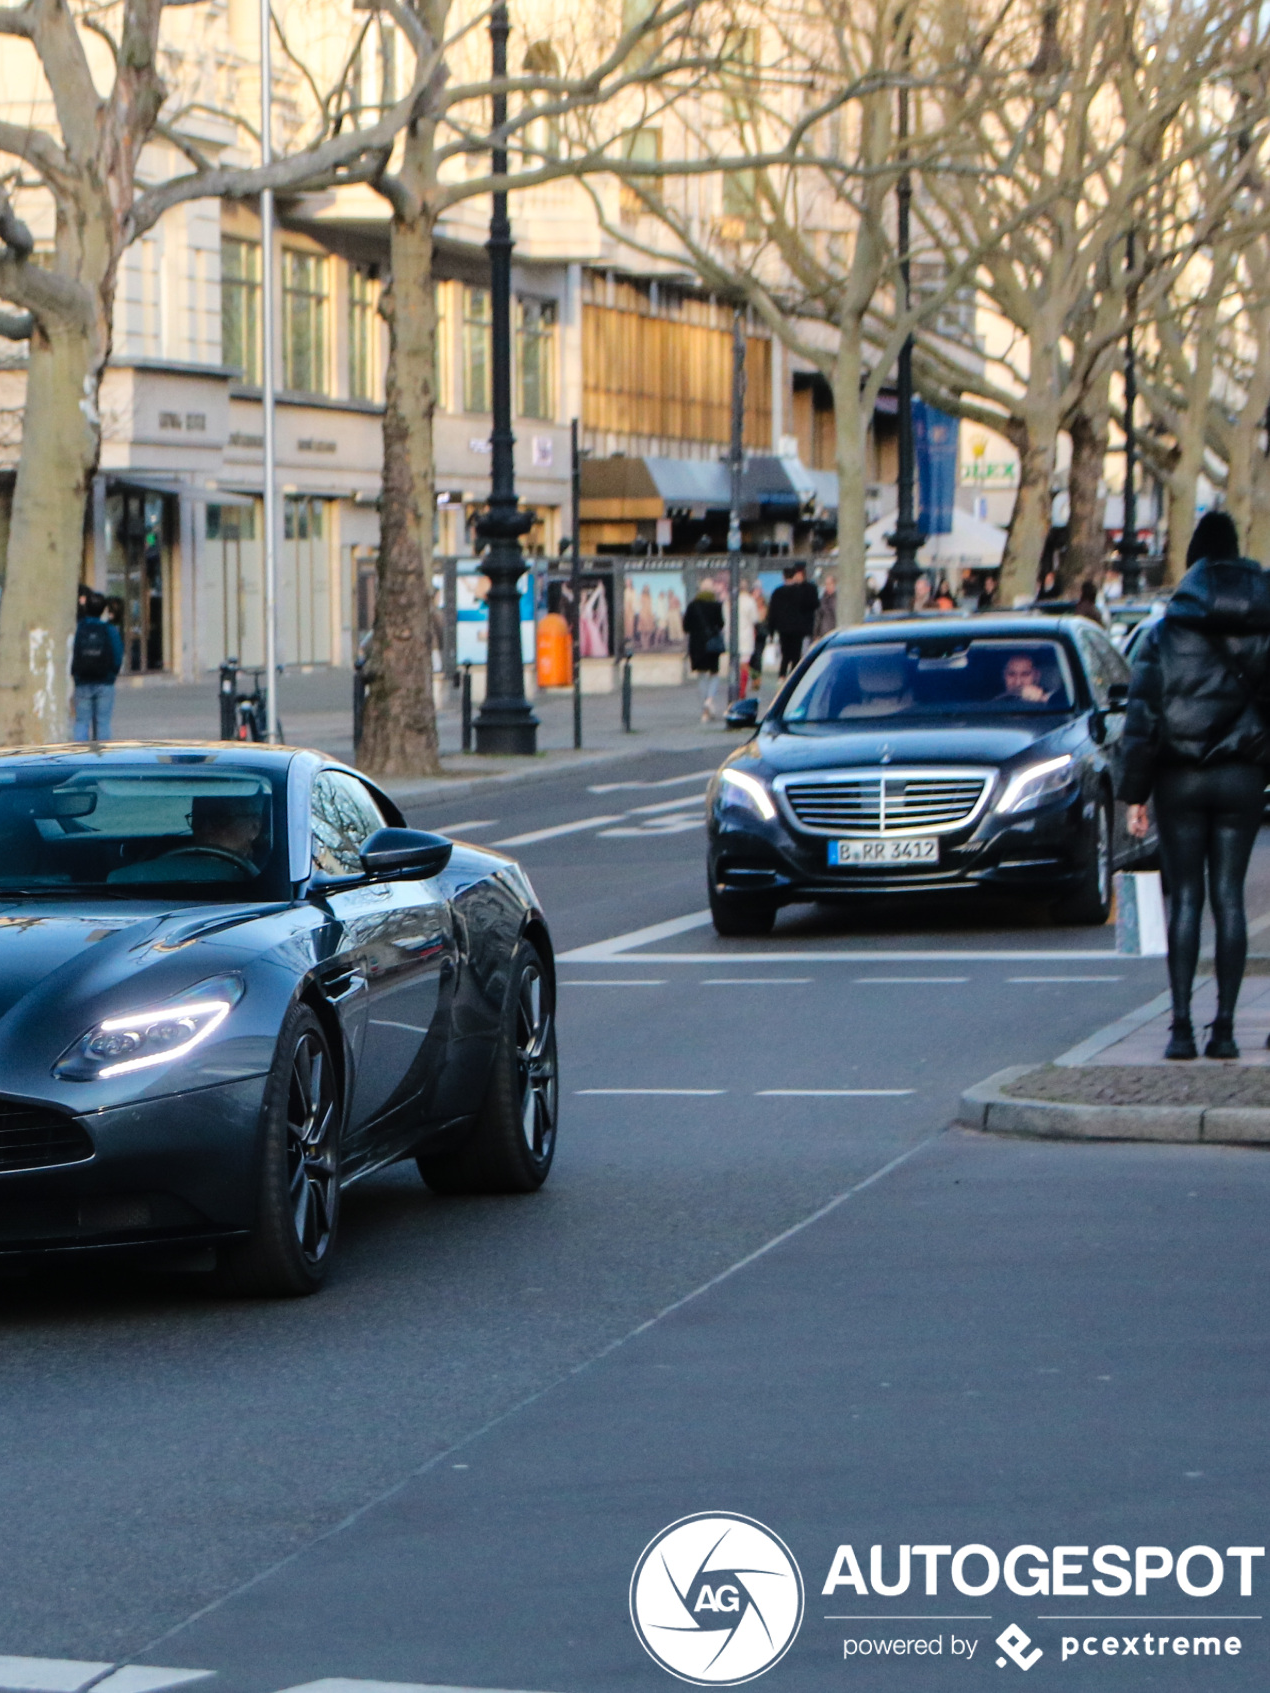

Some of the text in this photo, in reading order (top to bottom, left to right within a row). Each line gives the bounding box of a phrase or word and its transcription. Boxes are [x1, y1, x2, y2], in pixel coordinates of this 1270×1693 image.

[840, 841, 935, 861] B RR 3412
